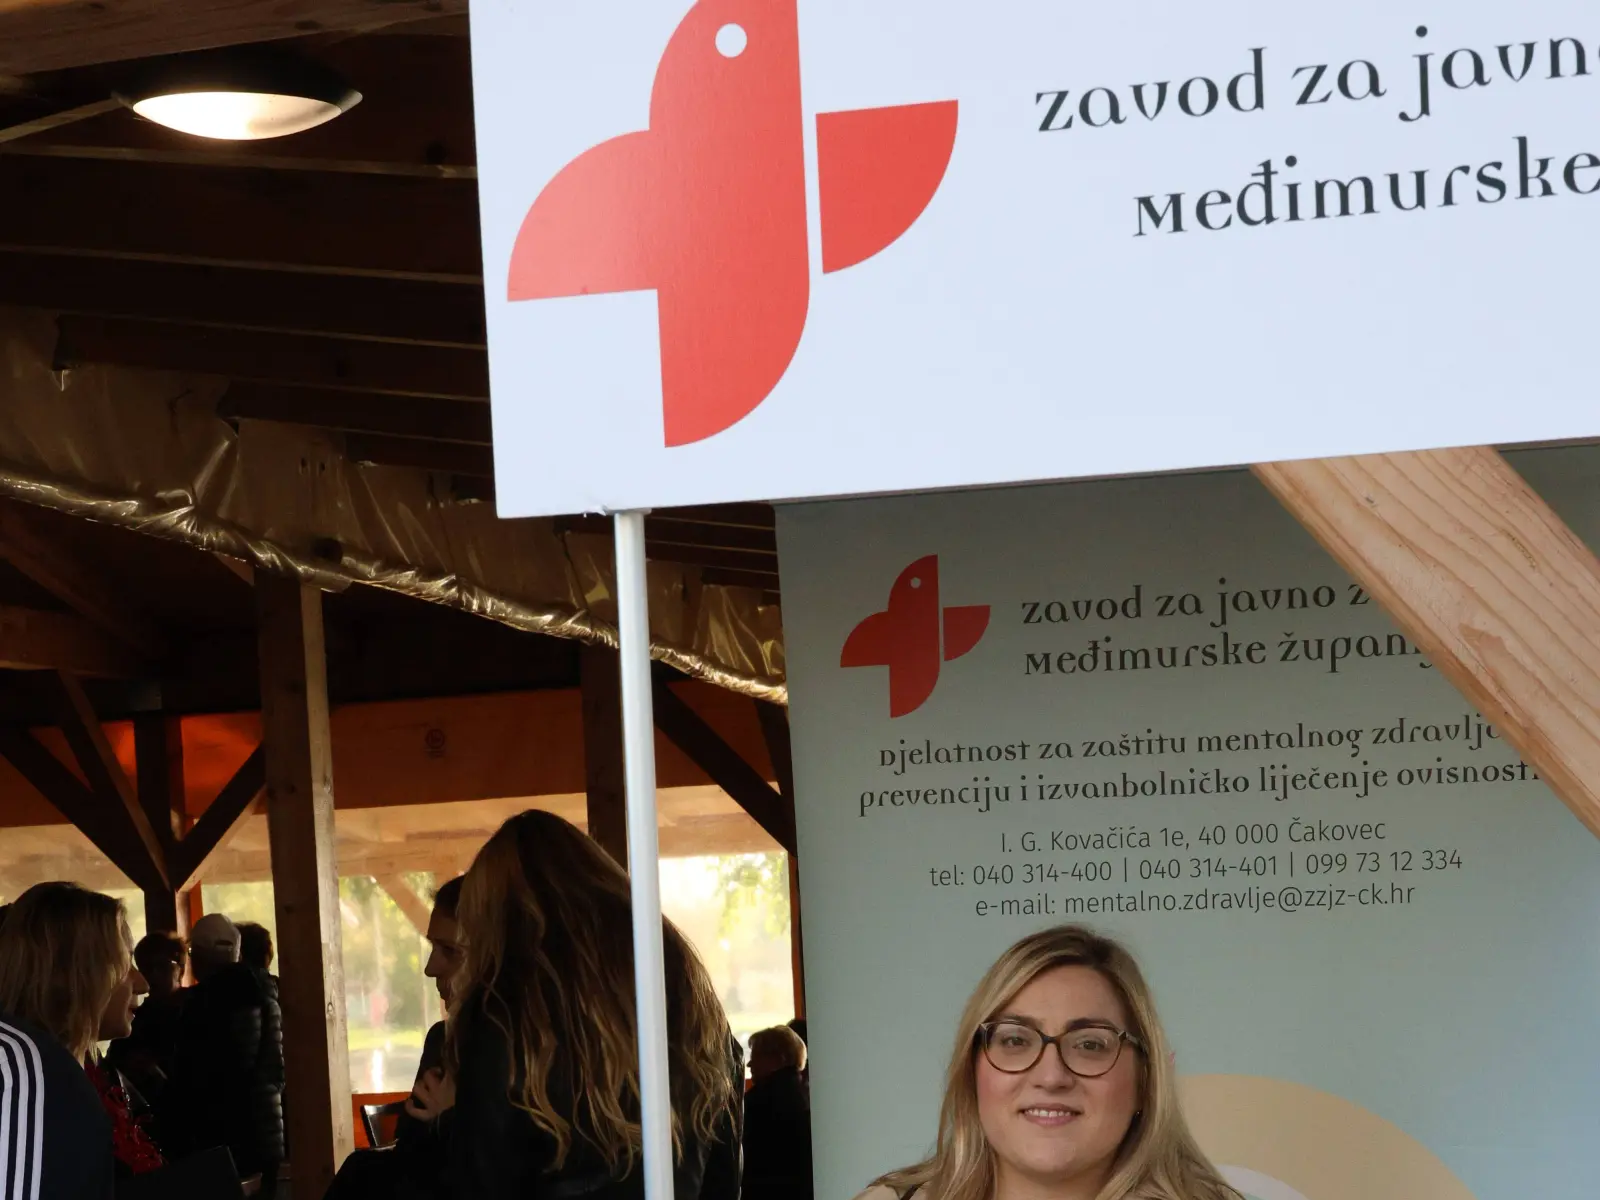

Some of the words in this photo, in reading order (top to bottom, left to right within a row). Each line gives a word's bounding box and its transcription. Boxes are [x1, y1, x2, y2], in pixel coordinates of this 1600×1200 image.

[1035, 46, 1268, 132] zavod
[1291, 58, 1388, 107] za
[1398, 25, 1600, 122] javn
[1021, 584, 1143, 625] zavod
[1154, 591, 1205, 618] za
[1209, 577, 1337, 629] javno
[879, 738, 1031, 776] Djelatnost
[1037, 742, 1074, 761] za
[1081, 728, 1188, 760] zaštitu
[1196, 722, 1364, 758] mentalnog
[858, 775, 1011, 818] prevenciju
[1019, 774, 1029, 802] i
[1037, 766, 1251, 802] izvanbolničko
[1258, 759, 1389, 802] liječenje
[1020, 831, 1042, 852] G.
[1050, 825, 1151, 851] Kovačića
[1198, 824, 1226, 846] 40
[1235, 823, 1279, 845] 000
[1288, 816, 1387, 844] Čakovec
[929, 864, 965, 887] tel:
[972, 863, 1015, 886] 040
[1021, 860, 1113, 884] 314-400
[1139, 857, 1182, 881] 040
[1188, 855, 1278, 878] 314-401
[1305, 853, 1348, 875] 099
[1355, 851, 1381, 873] 73
[1389, 850, 1413, 872] 12
[1421, 848, 1463, 871] 334
[975, 892, 1057, 916] e-mail:
[1065, 882, 1416, 914] mentalno.zdravlje@zzjz-ck.hr
